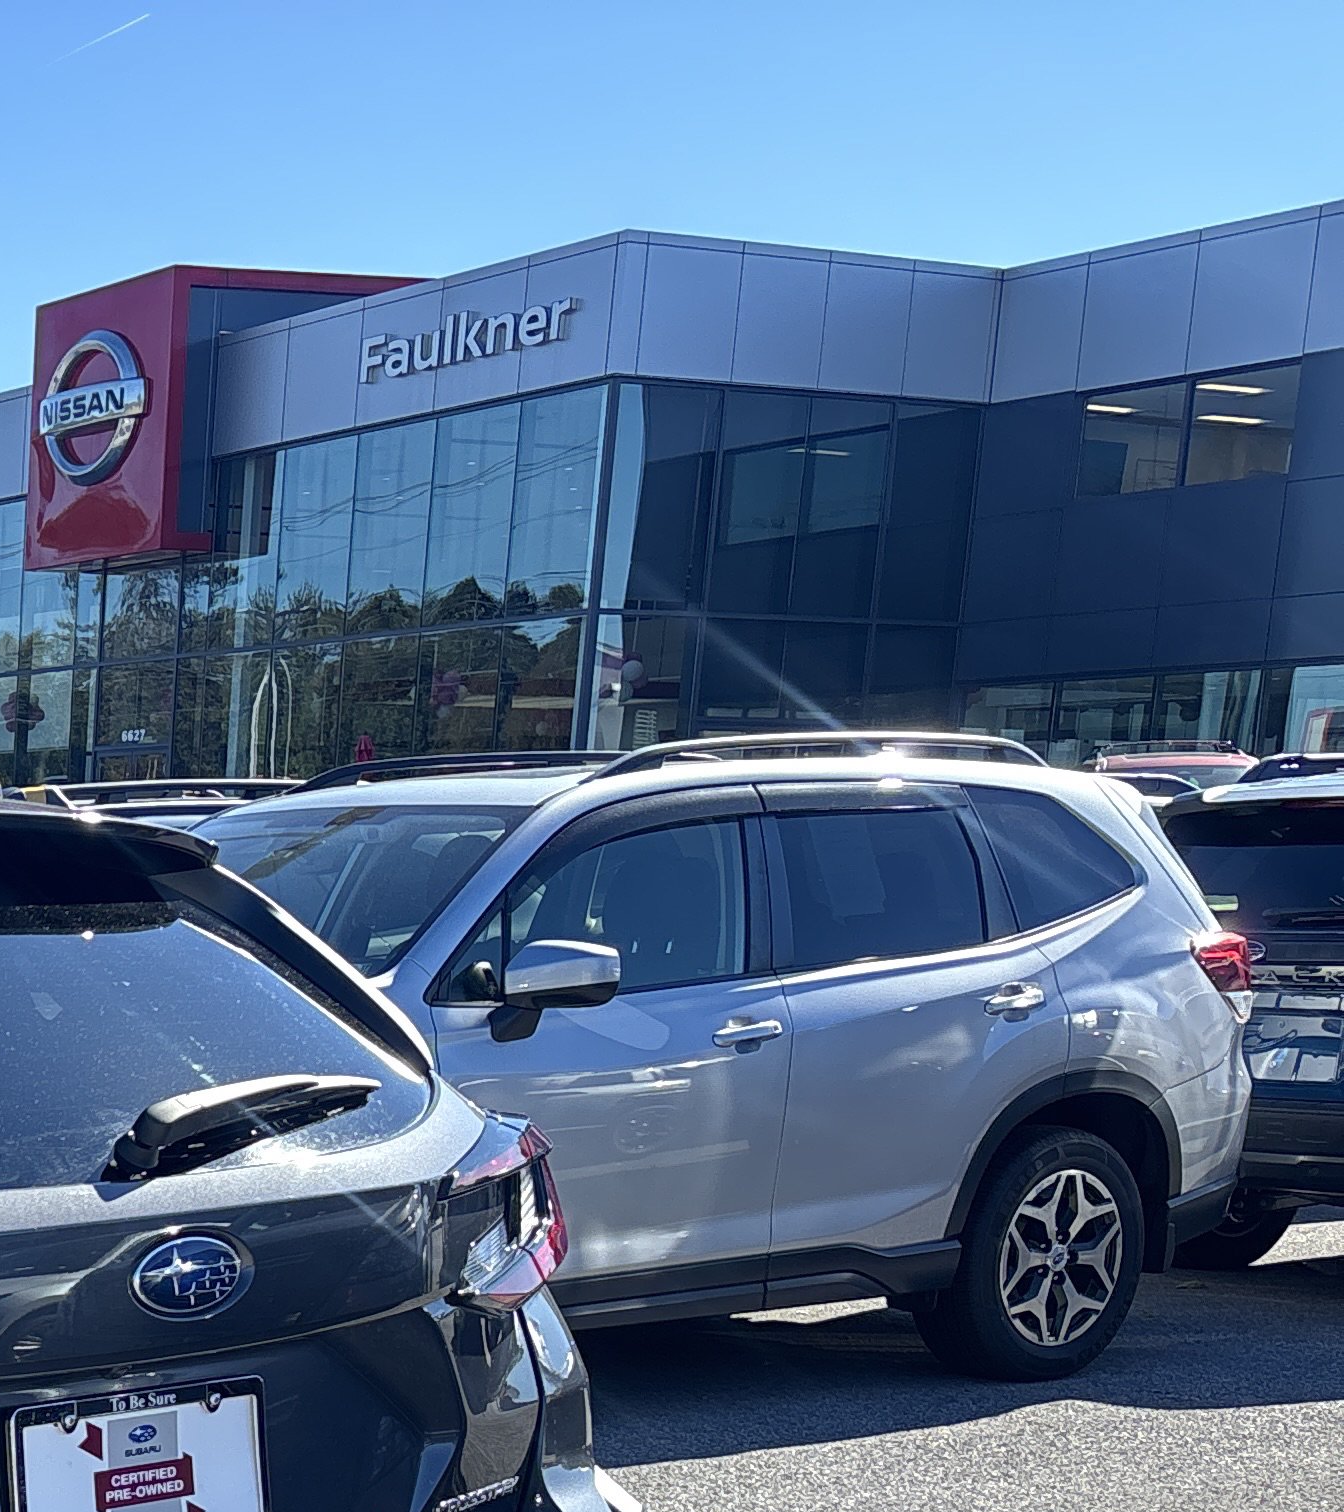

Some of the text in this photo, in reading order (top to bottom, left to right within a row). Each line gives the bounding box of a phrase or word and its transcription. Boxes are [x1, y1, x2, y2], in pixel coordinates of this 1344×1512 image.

[359, 296, 578, 384] Faulkner
[41, 386, 125, 428] NISSAN
[121, 728, 146, 742] 6627
[109, 1392, 177, 1412] To Be Sure
[124, 1444, 162, 1457] SUBARU
[110, 1465, 177, 1488] CERTIFIED
[105, 1479, 185, 1503] PRE-OWNED
